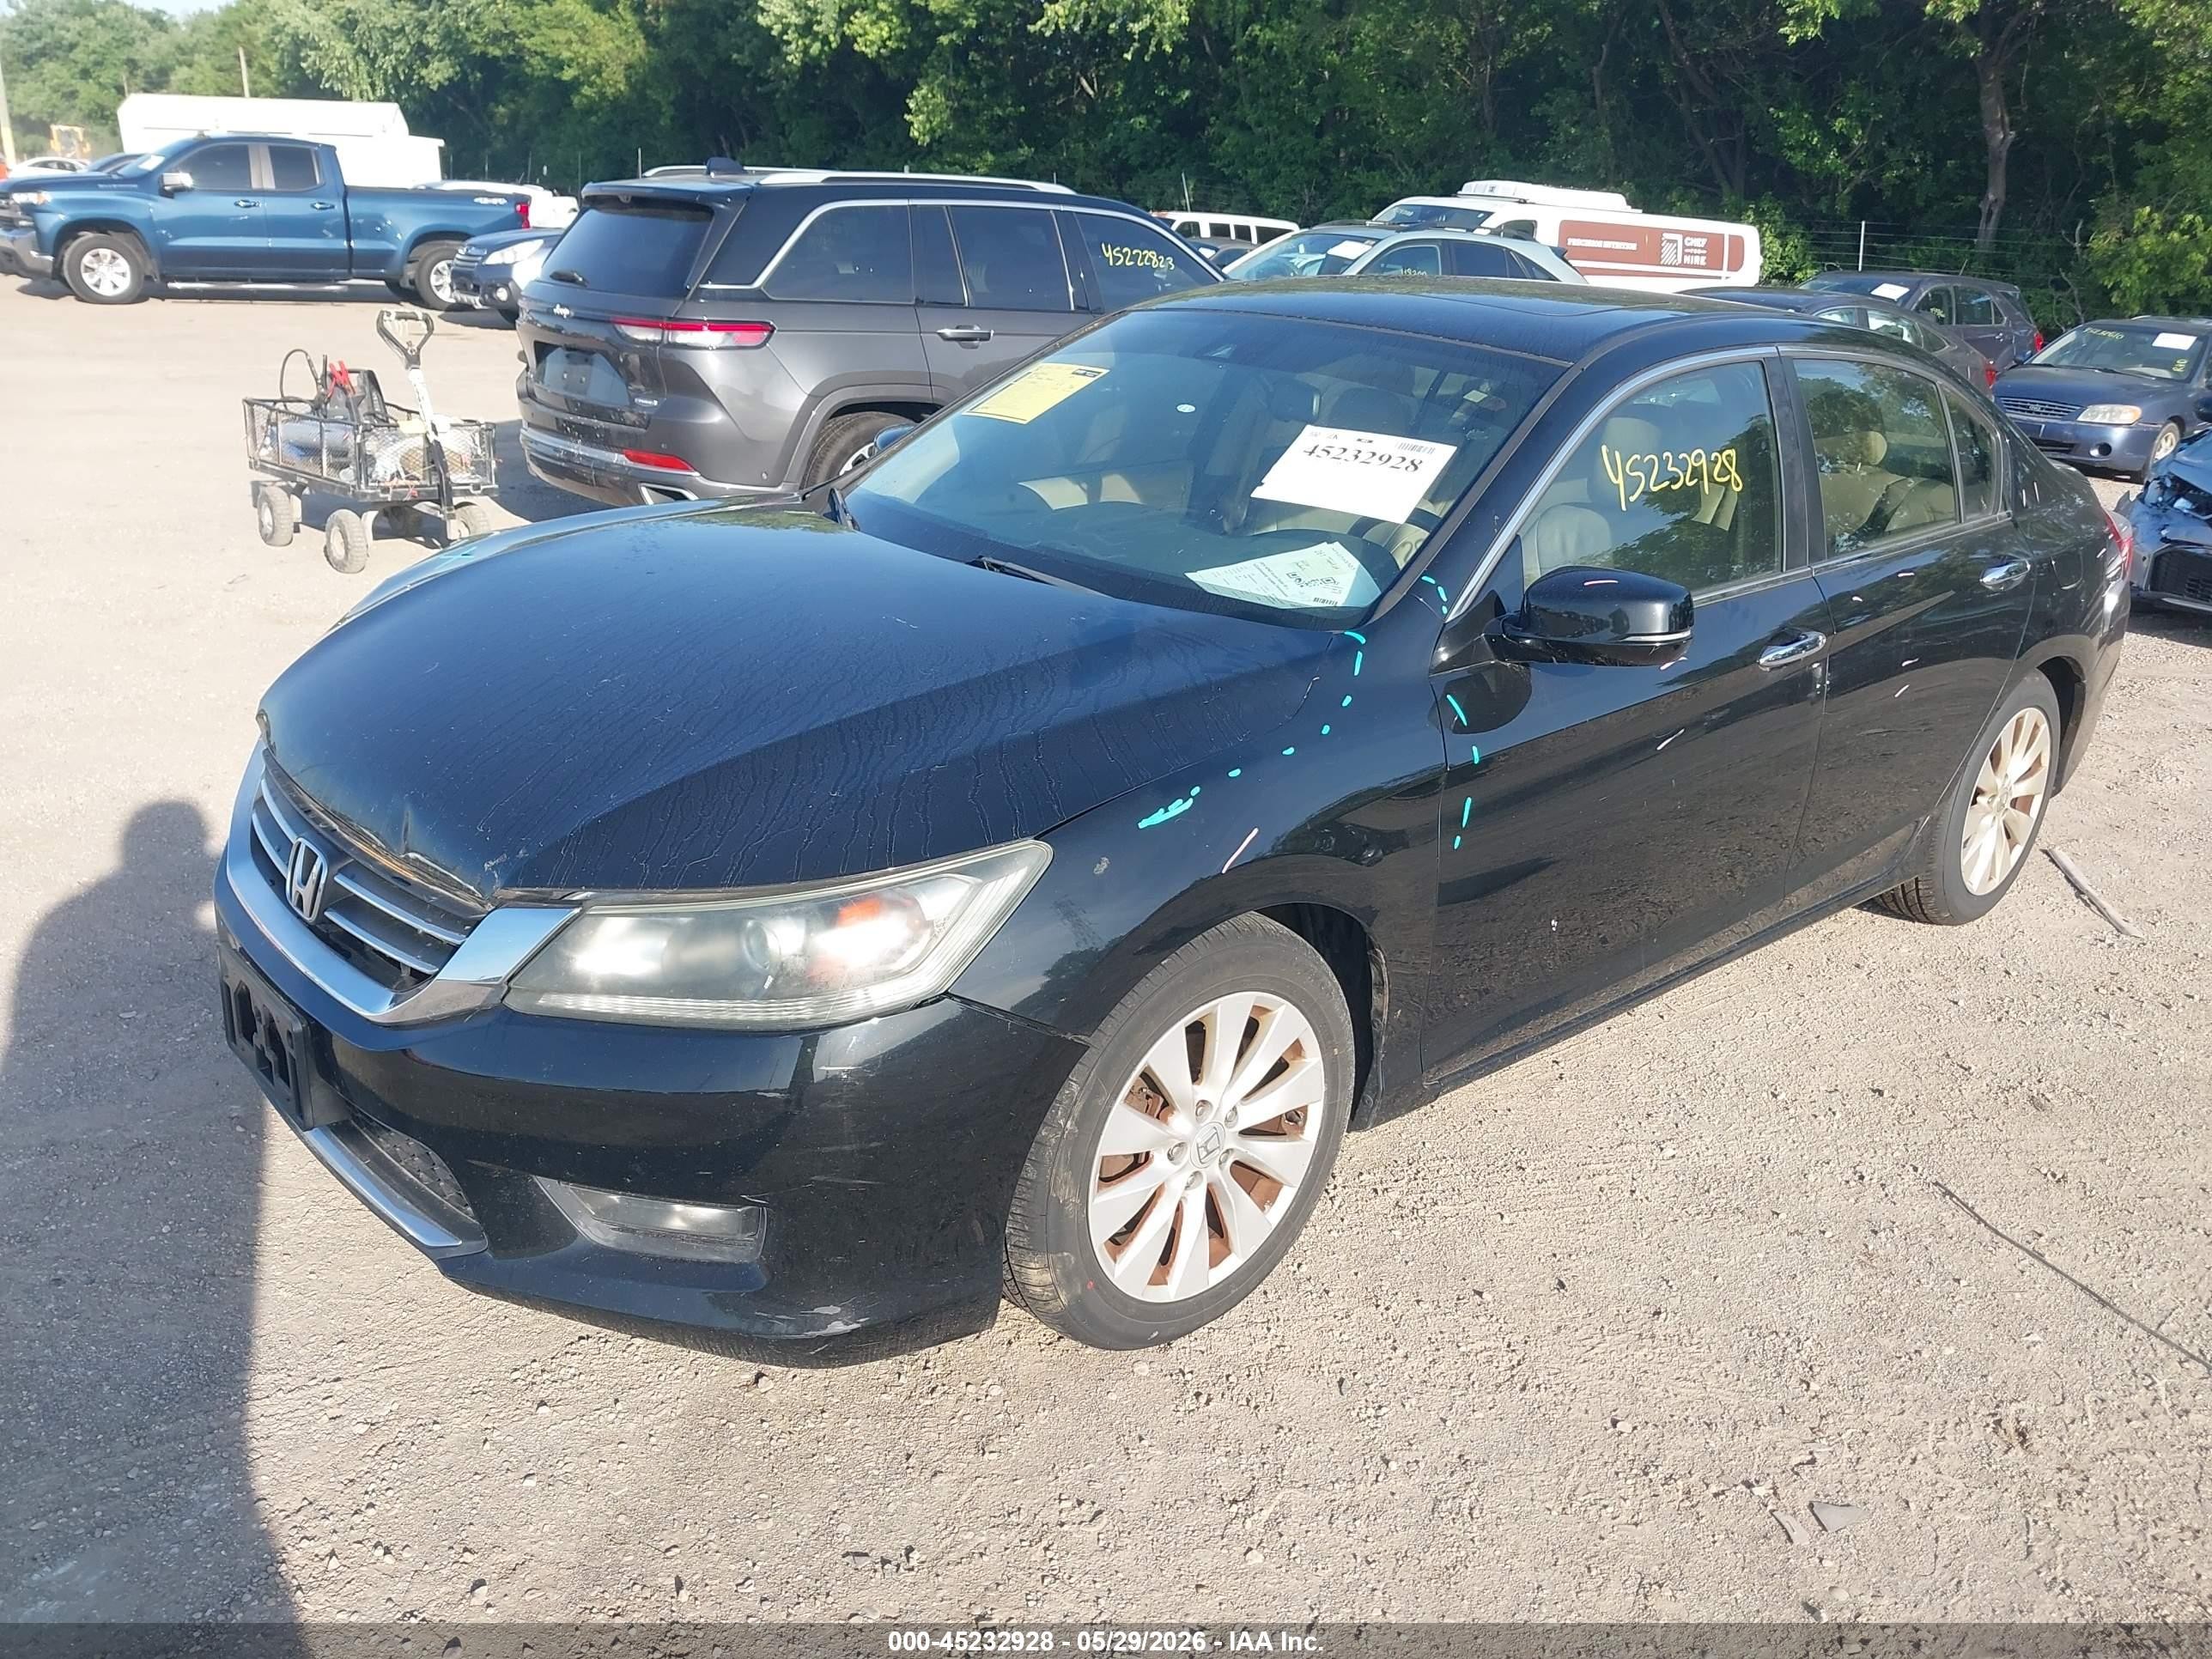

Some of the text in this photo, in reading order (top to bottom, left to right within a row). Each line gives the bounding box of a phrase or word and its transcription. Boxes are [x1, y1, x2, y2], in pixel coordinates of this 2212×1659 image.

[1102, 242, 1175, 270] 45222823
[1684, 255, 1707, 265] HIRE
[1304, 443, 1423, 473] 45232928
[1601, 444, 1743, 512] 45232928
